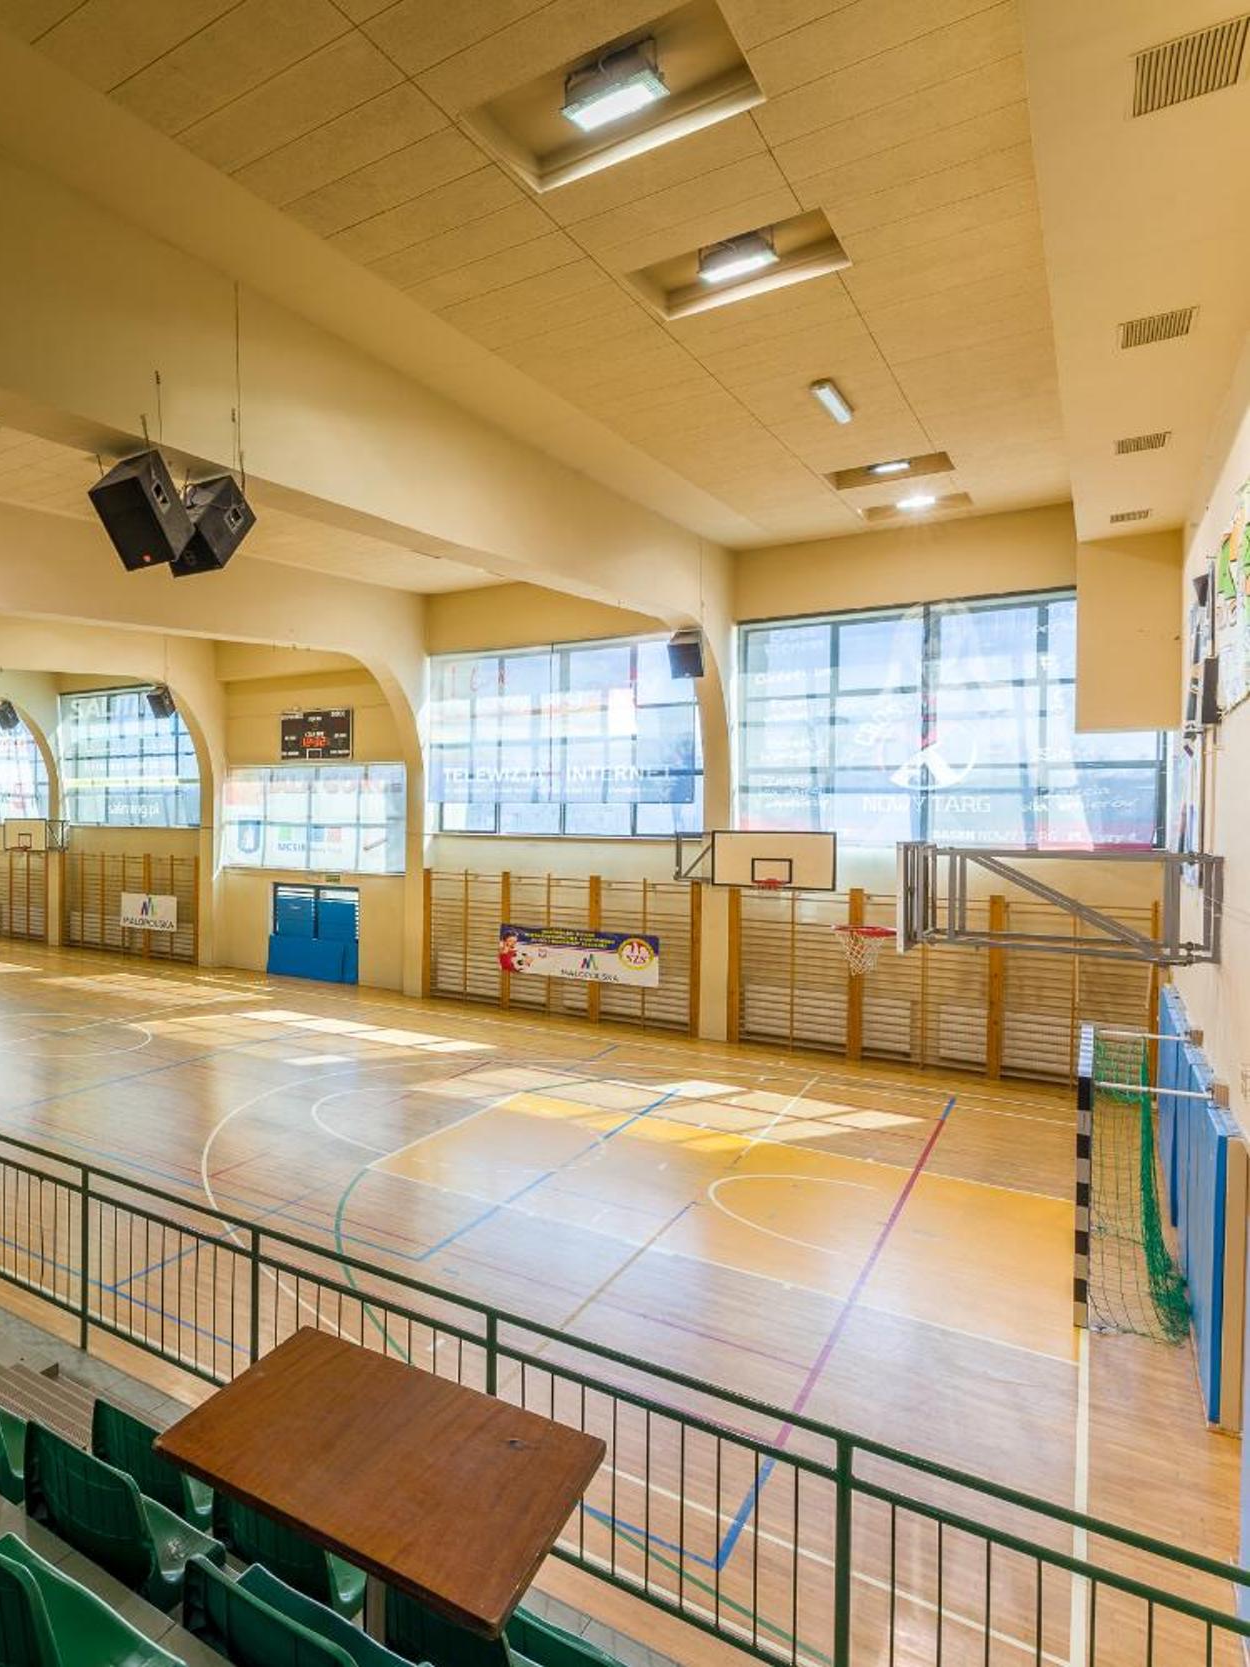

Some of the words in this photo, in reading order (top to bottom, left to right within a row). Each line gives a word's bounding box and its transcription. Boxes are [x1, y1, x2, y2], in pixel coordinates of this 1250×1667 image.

[566, 767, 671, 782] INTERNET
[862, 796, 927, 813] NOWY
[933, 796, 991, 813] TARG
